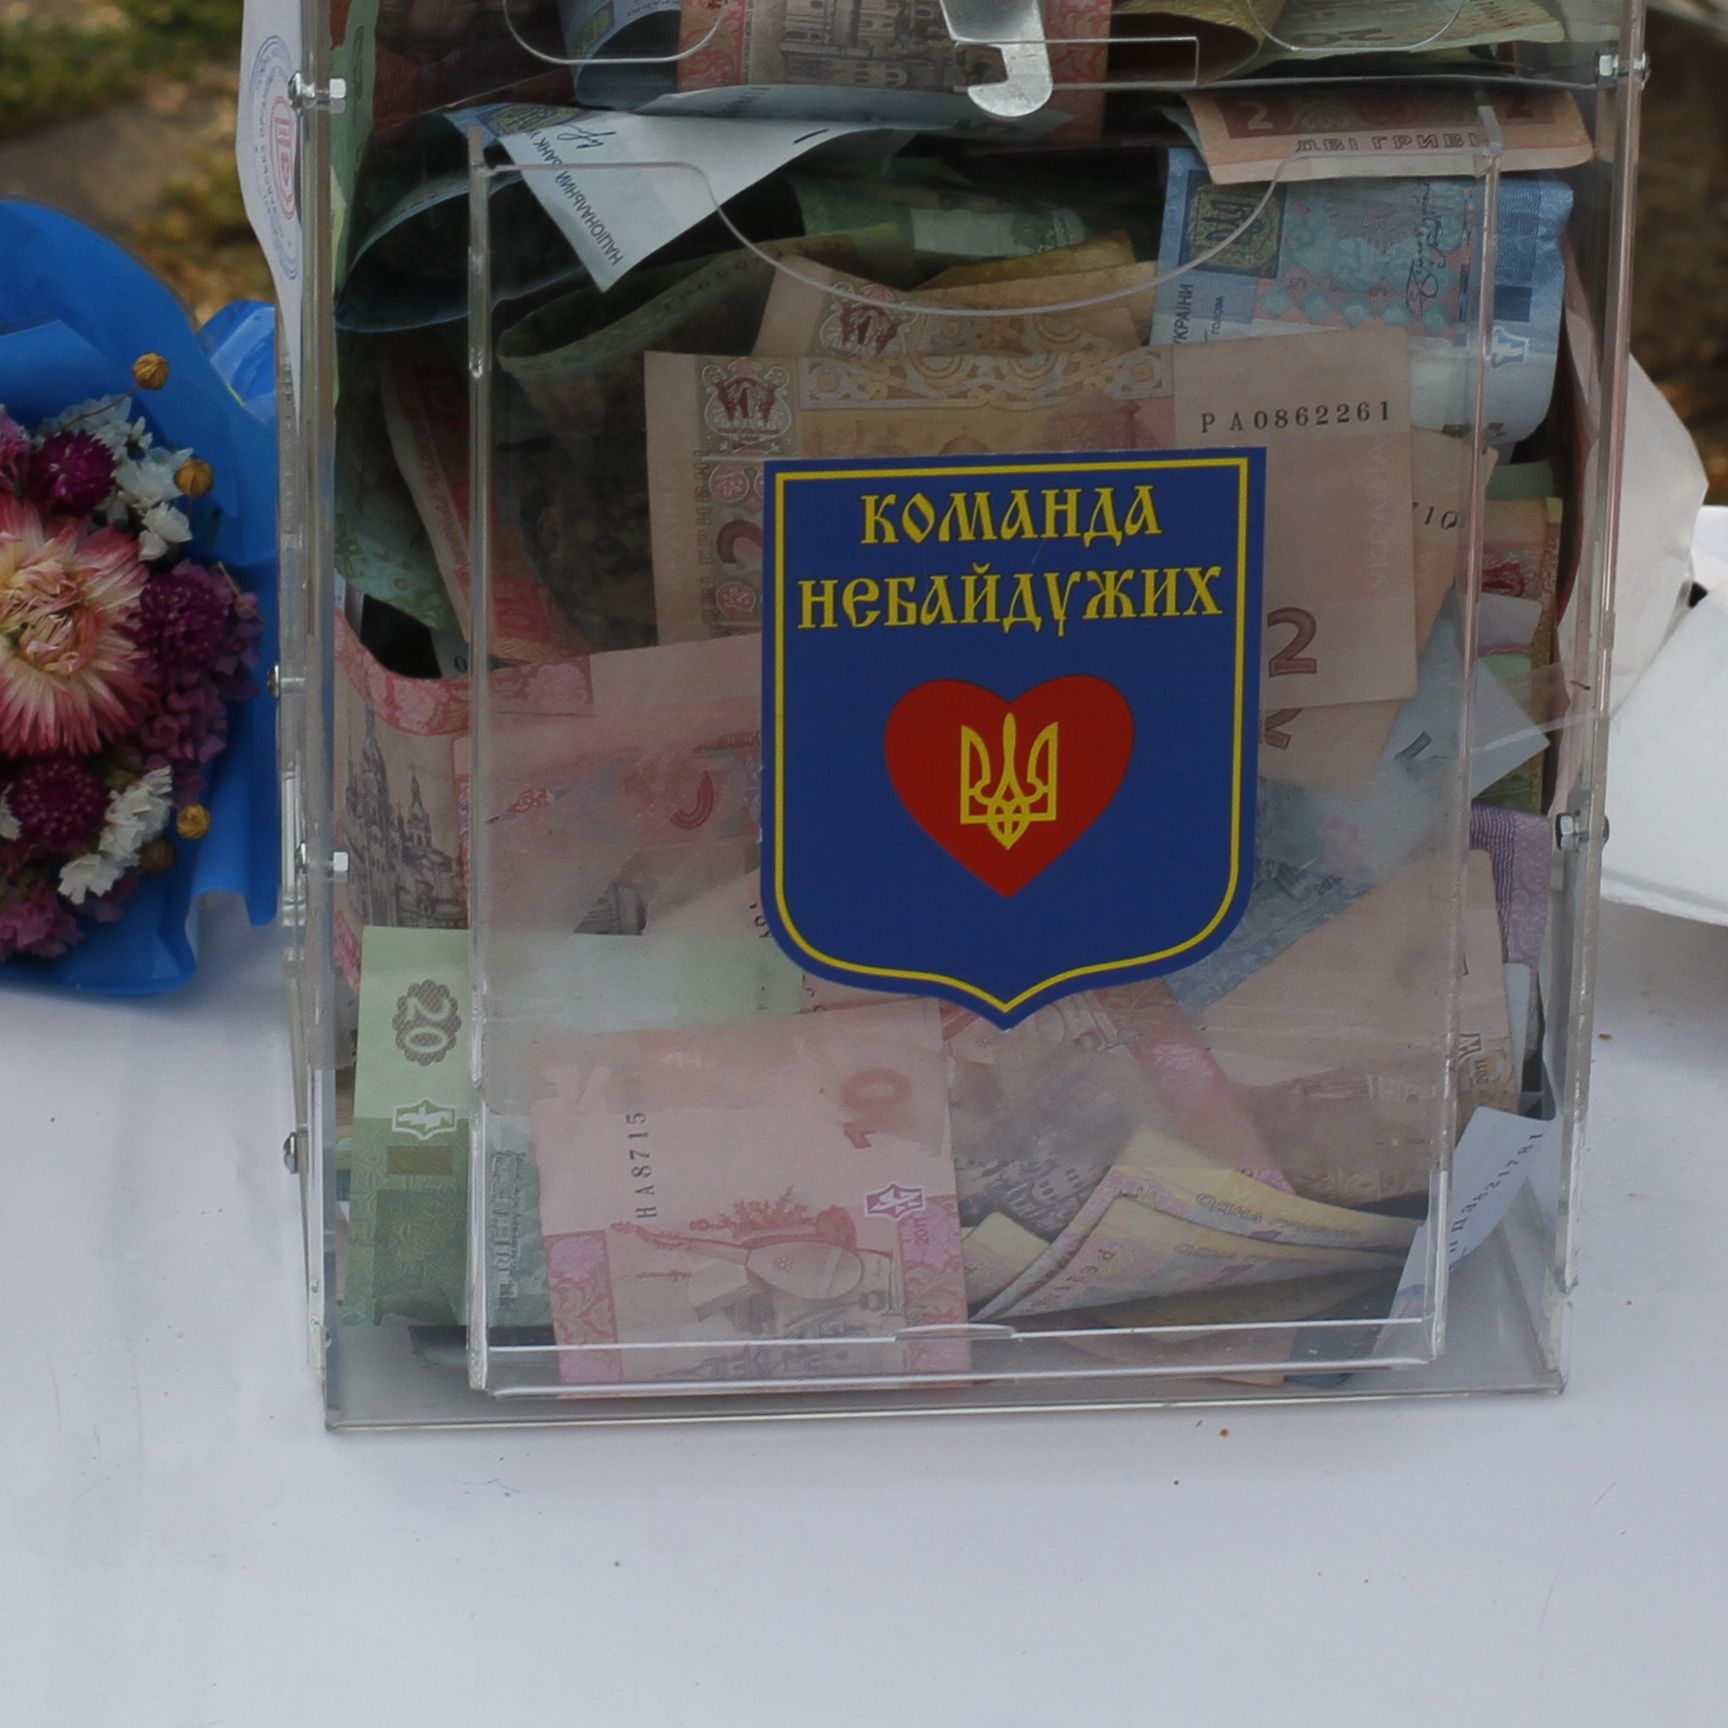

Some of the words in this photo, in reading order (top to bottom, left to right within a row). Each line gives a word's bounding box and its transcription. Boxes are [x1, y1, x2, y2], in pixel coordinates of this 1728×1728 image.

[553, 170, 625, 268] НАЦІОНАЛЬНИЙ
[859, 484, 1163, 549] КОМАНДА
[796, 562, 1225, 639] НЕБАЙДУЖИХ
[1267, 607, 1317, 678] 2
[403, 997, 450, 1053] 20
